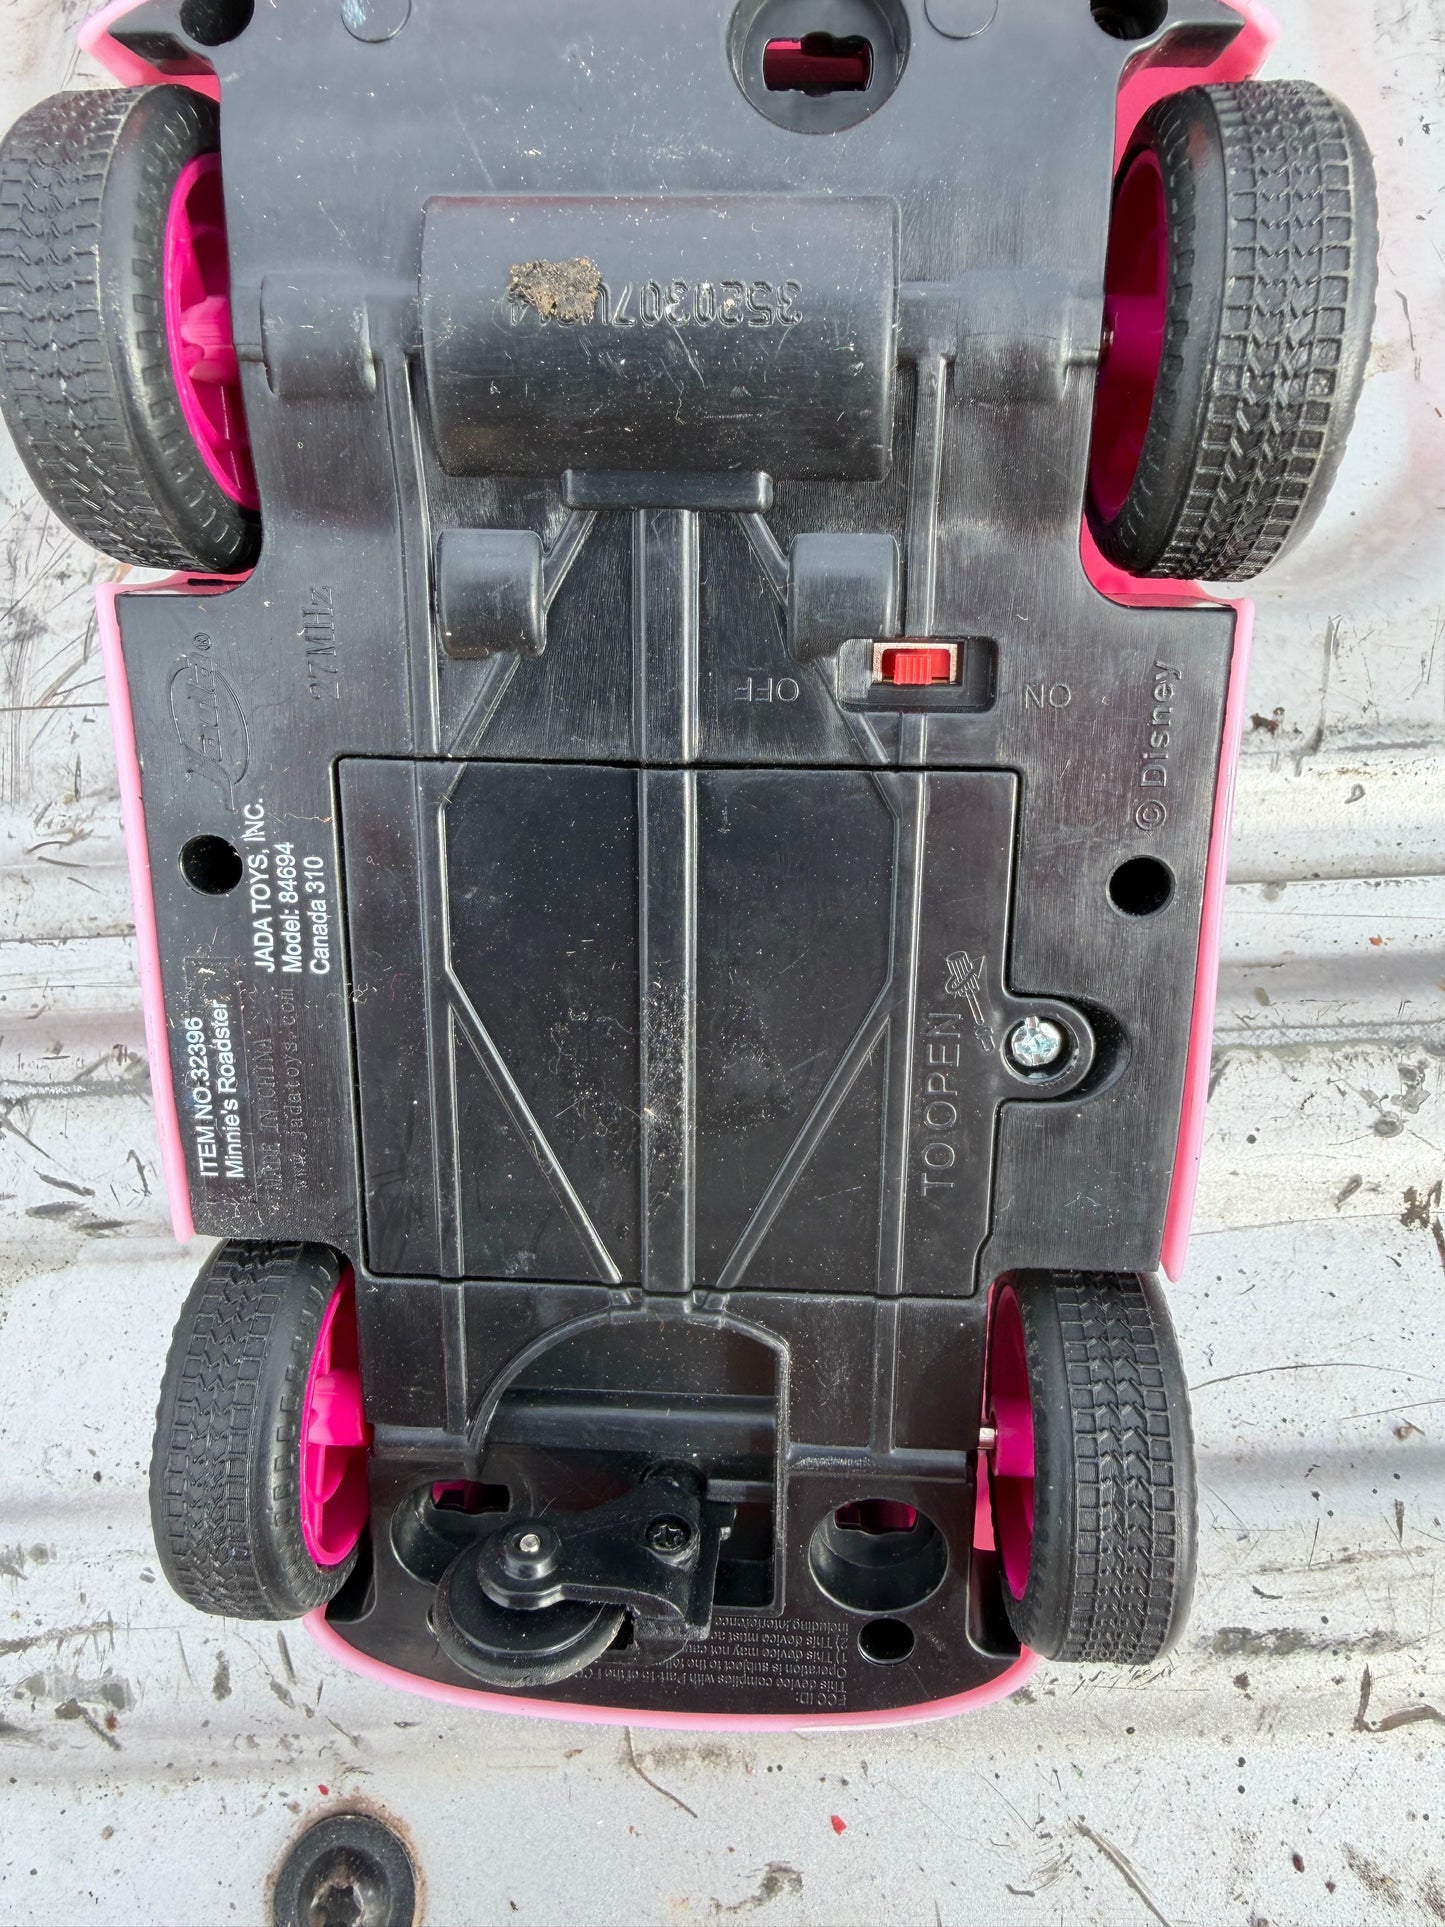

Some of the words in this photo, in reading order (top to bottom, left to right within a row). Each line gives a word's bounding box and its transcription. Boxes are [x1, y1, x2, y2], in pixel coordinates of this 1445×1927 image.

[301, 586, 339, 700] 27MHz
[734, 677, 799, 702] OFF
[1024, 684, 1071, 709] ON
[1140, 661, 1182, 787] Disney
[242, 798, 266, 841] INC.
[275, 842, 298, 903] 84694
[303, 857, 325, 894] 310
[248, 849, 271, 913] TOYS,
[279, 909, 302, 972] Model:
[307, 900, 330, 974] Canada
[253, 918, 275, 972] JADA
[211, 1000, 237, 1093] Roadster
[185, 1017, 213, 1119] NO.32396
[253, 1038, 276, 1100] CHINA
[923, 1012, 962, 1130] OPEN
[259, 1109, 279, 1133] IN
[221, 1099, 245, 1178] Minnie's
[195, 1122, 219, 1176] ITEM
[262, 1143, 283, 1189] MADE
[715, 1617, 789, 1631] interference
[793, 1619, 848, 1634] including
[728, 1632, 758, 1644] must
[762, 1634, 802, 1646] device
[806, 1636, 832, 1649] This
[836, 1635, 848, 1649] 2)
[711, 1646, 730, 1658] not
[733, 1644, 758, 1656] may
[762, 1648, 803, 1661] device
[807, 1651, 832, 1663] This
[836, 1649, 847, 1664] 1)
[688, 1659, 706, 1671] the
[710, 1660, 721, 1672] to
[724, 1659, 768, 1673] subject
[772, 1664, 782, 1675] is
[786, 1664, 846, 1678] Operation
[689, 1673, 714, 1687] with
[718, 1674, 772, 1687] complies
[776, 1678, 816, 1690] device
[820, 1680, 846, 1692] This
[795, 1692, 813, 1704] ID:
[818, 1693, 846, 1706] FCC
